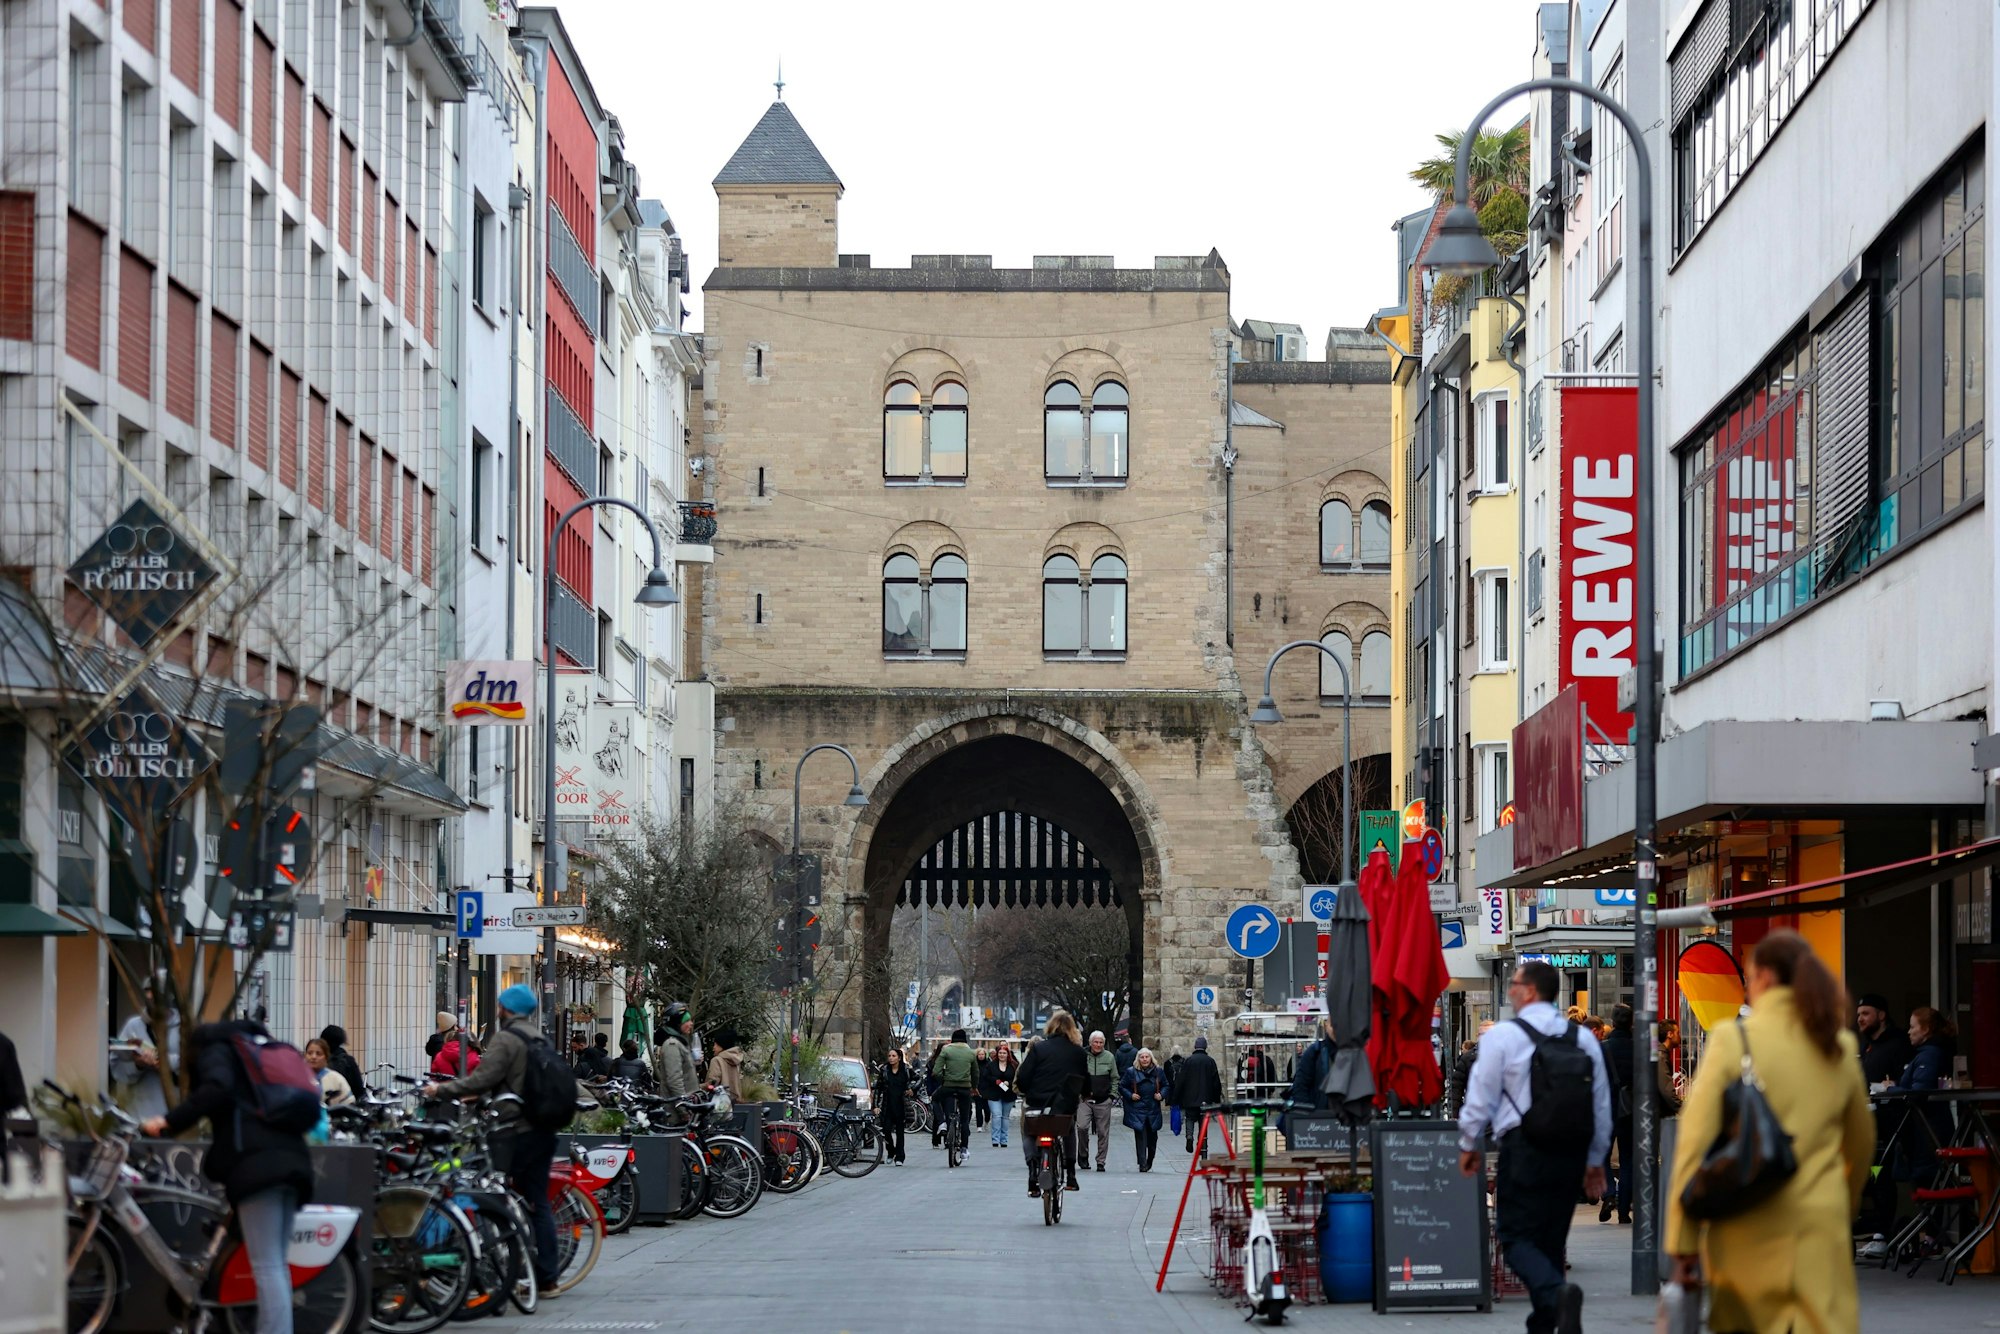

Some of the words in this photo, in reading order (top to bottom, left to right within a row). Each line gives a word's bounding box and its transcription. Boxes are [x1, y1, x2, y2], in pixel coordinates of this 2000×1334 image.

[1571, 454, 1634, 677] REWE
[465, 671, 518, 702] dm
[556, 793, 589, 804] OOR
[593, 814, 631, 825] BOOR
